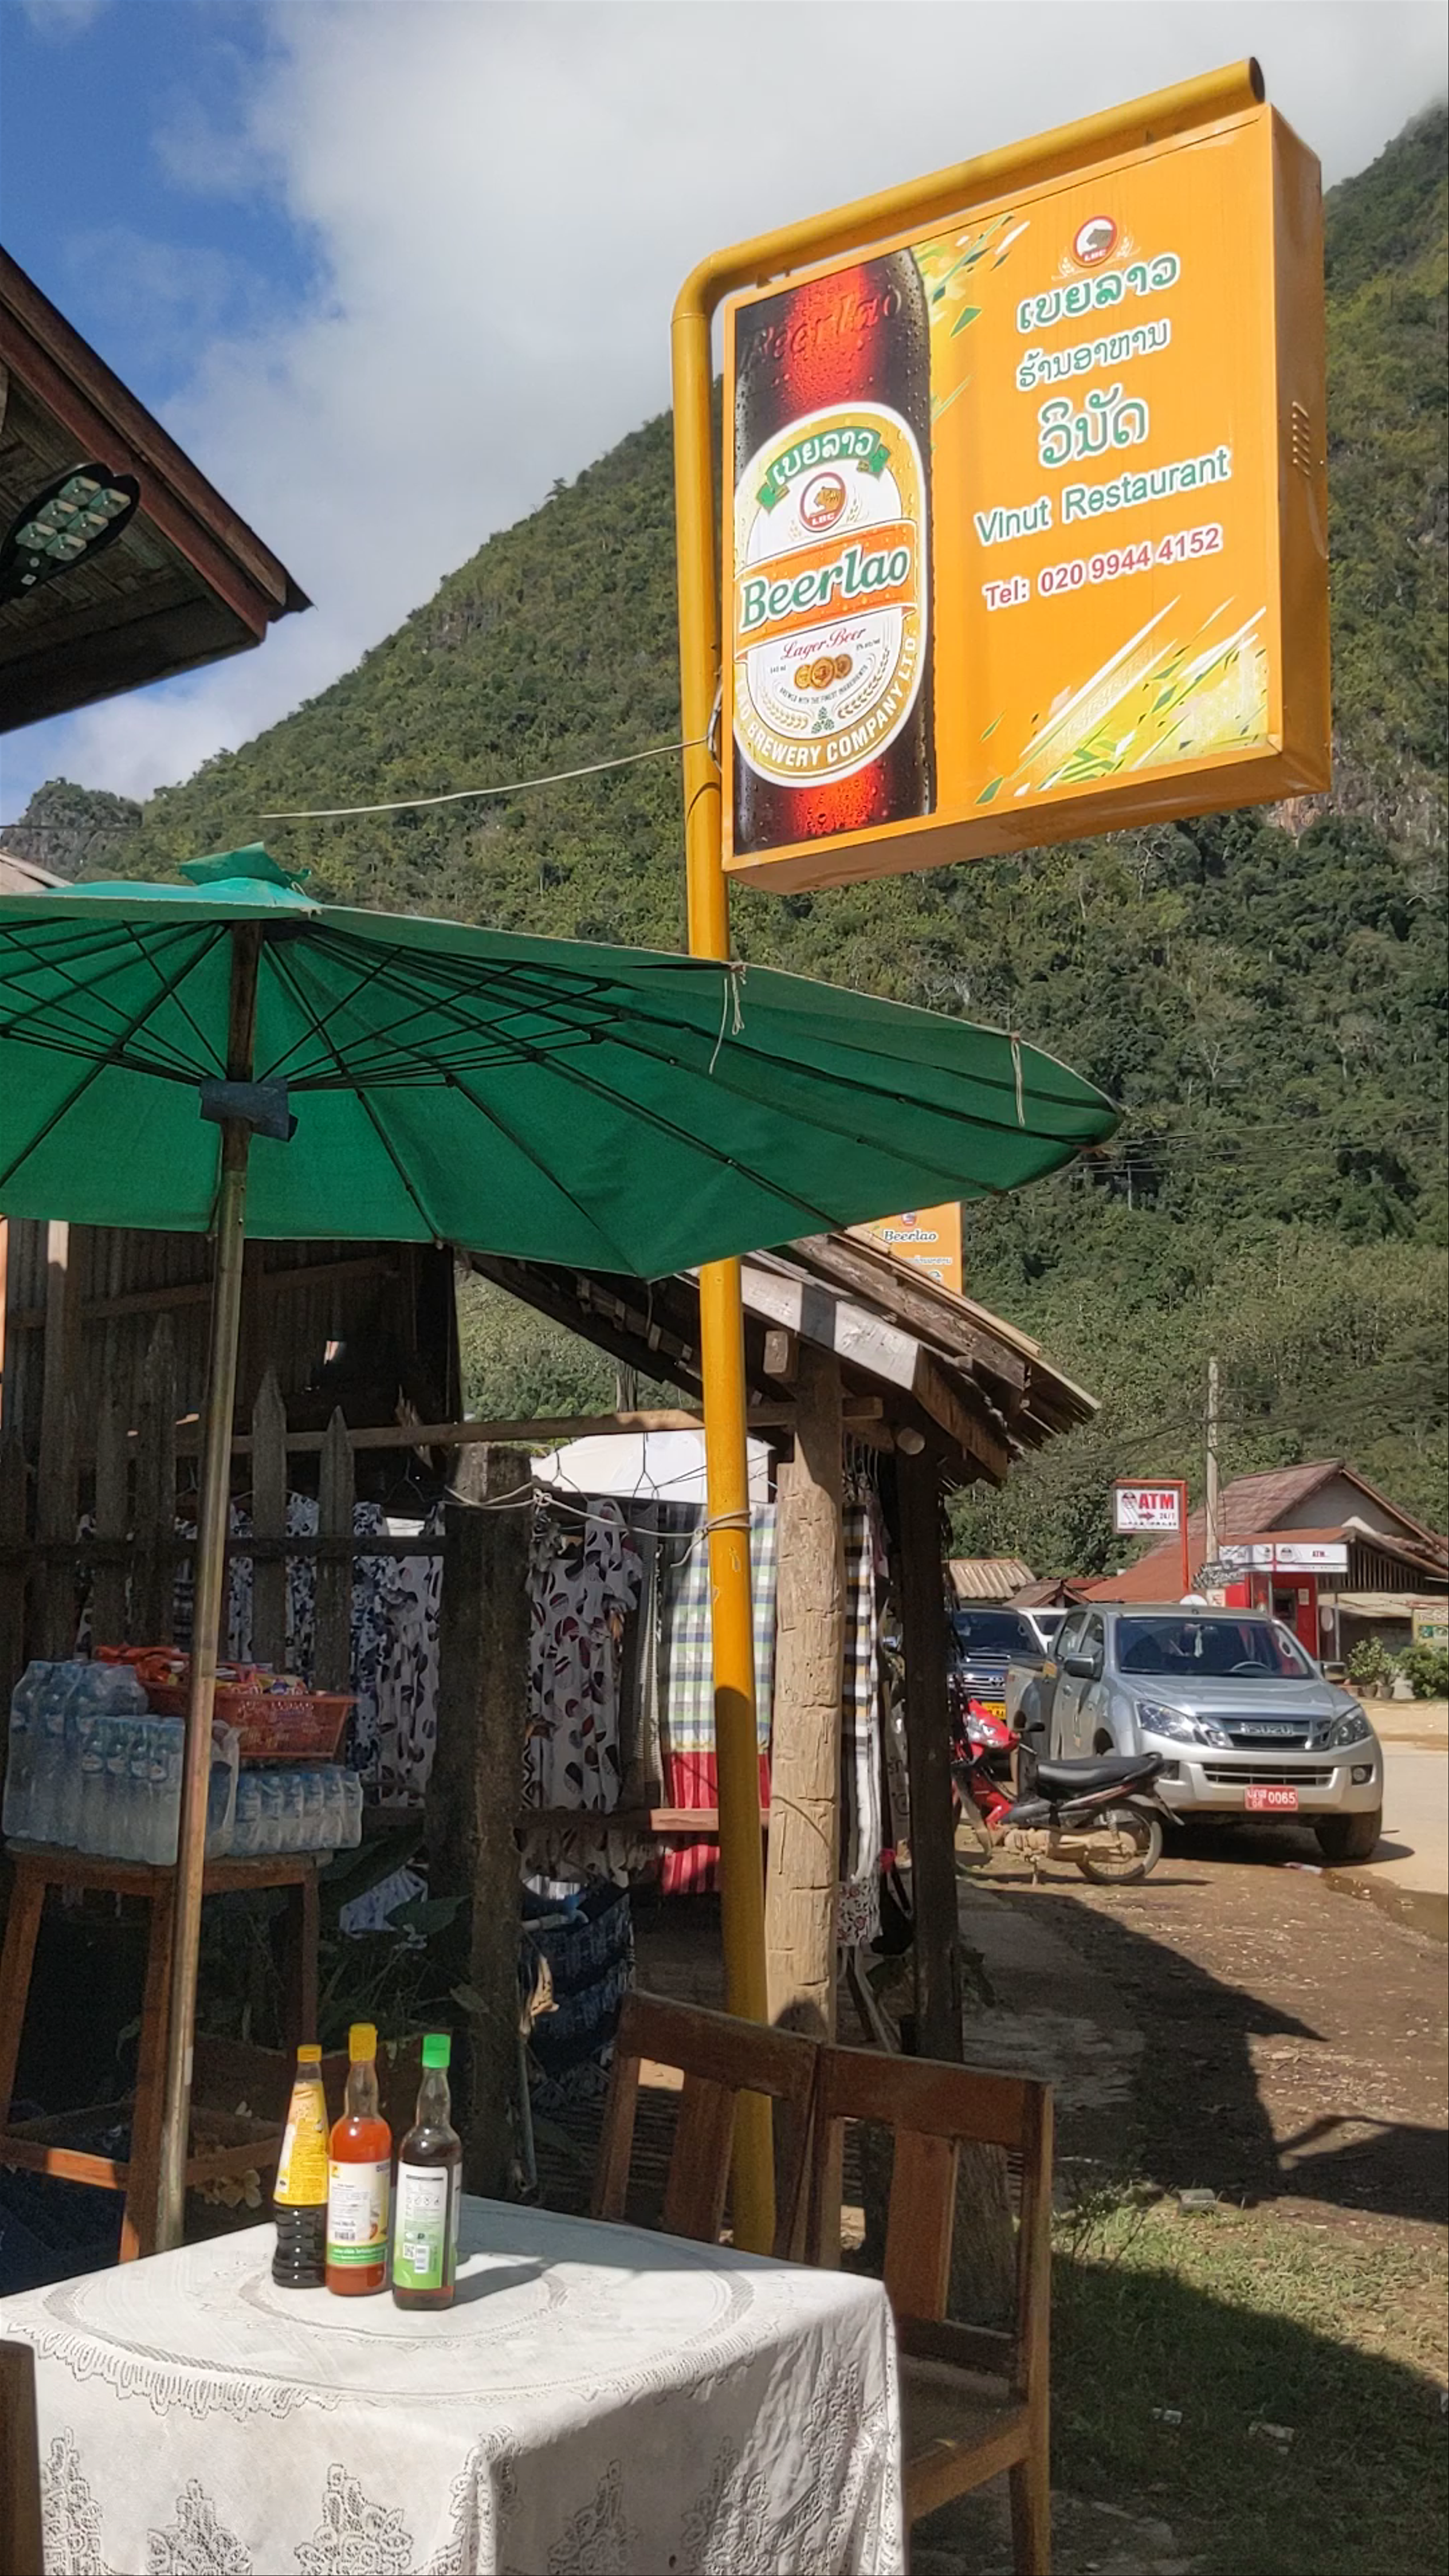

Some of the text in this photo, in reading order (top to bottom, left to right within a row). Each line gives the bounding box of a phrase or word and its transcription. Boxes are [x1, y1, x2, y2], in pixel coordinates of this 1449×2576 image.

[1018, 254, 1178, 331] ເບຍລາວ
[773, 431, 873, 485] ເບຍລາວ
[1063, 449, 1228, 520] Restaurant
[742, 548, 909, 629] Beerlao
[984, 527, 1220, 607] Tel: 020 9944 4152
[780, 628, 866, 660] Lager Beer
[748, 721, 821, 767] BREWERY
[826, 681, 903, 763] COMPANY
[884, 1229, 937, 1241] Beerlao
[1139, 1493, 1174, 1509] ATM
[1268, 1792, 1296, 1804] 0065
